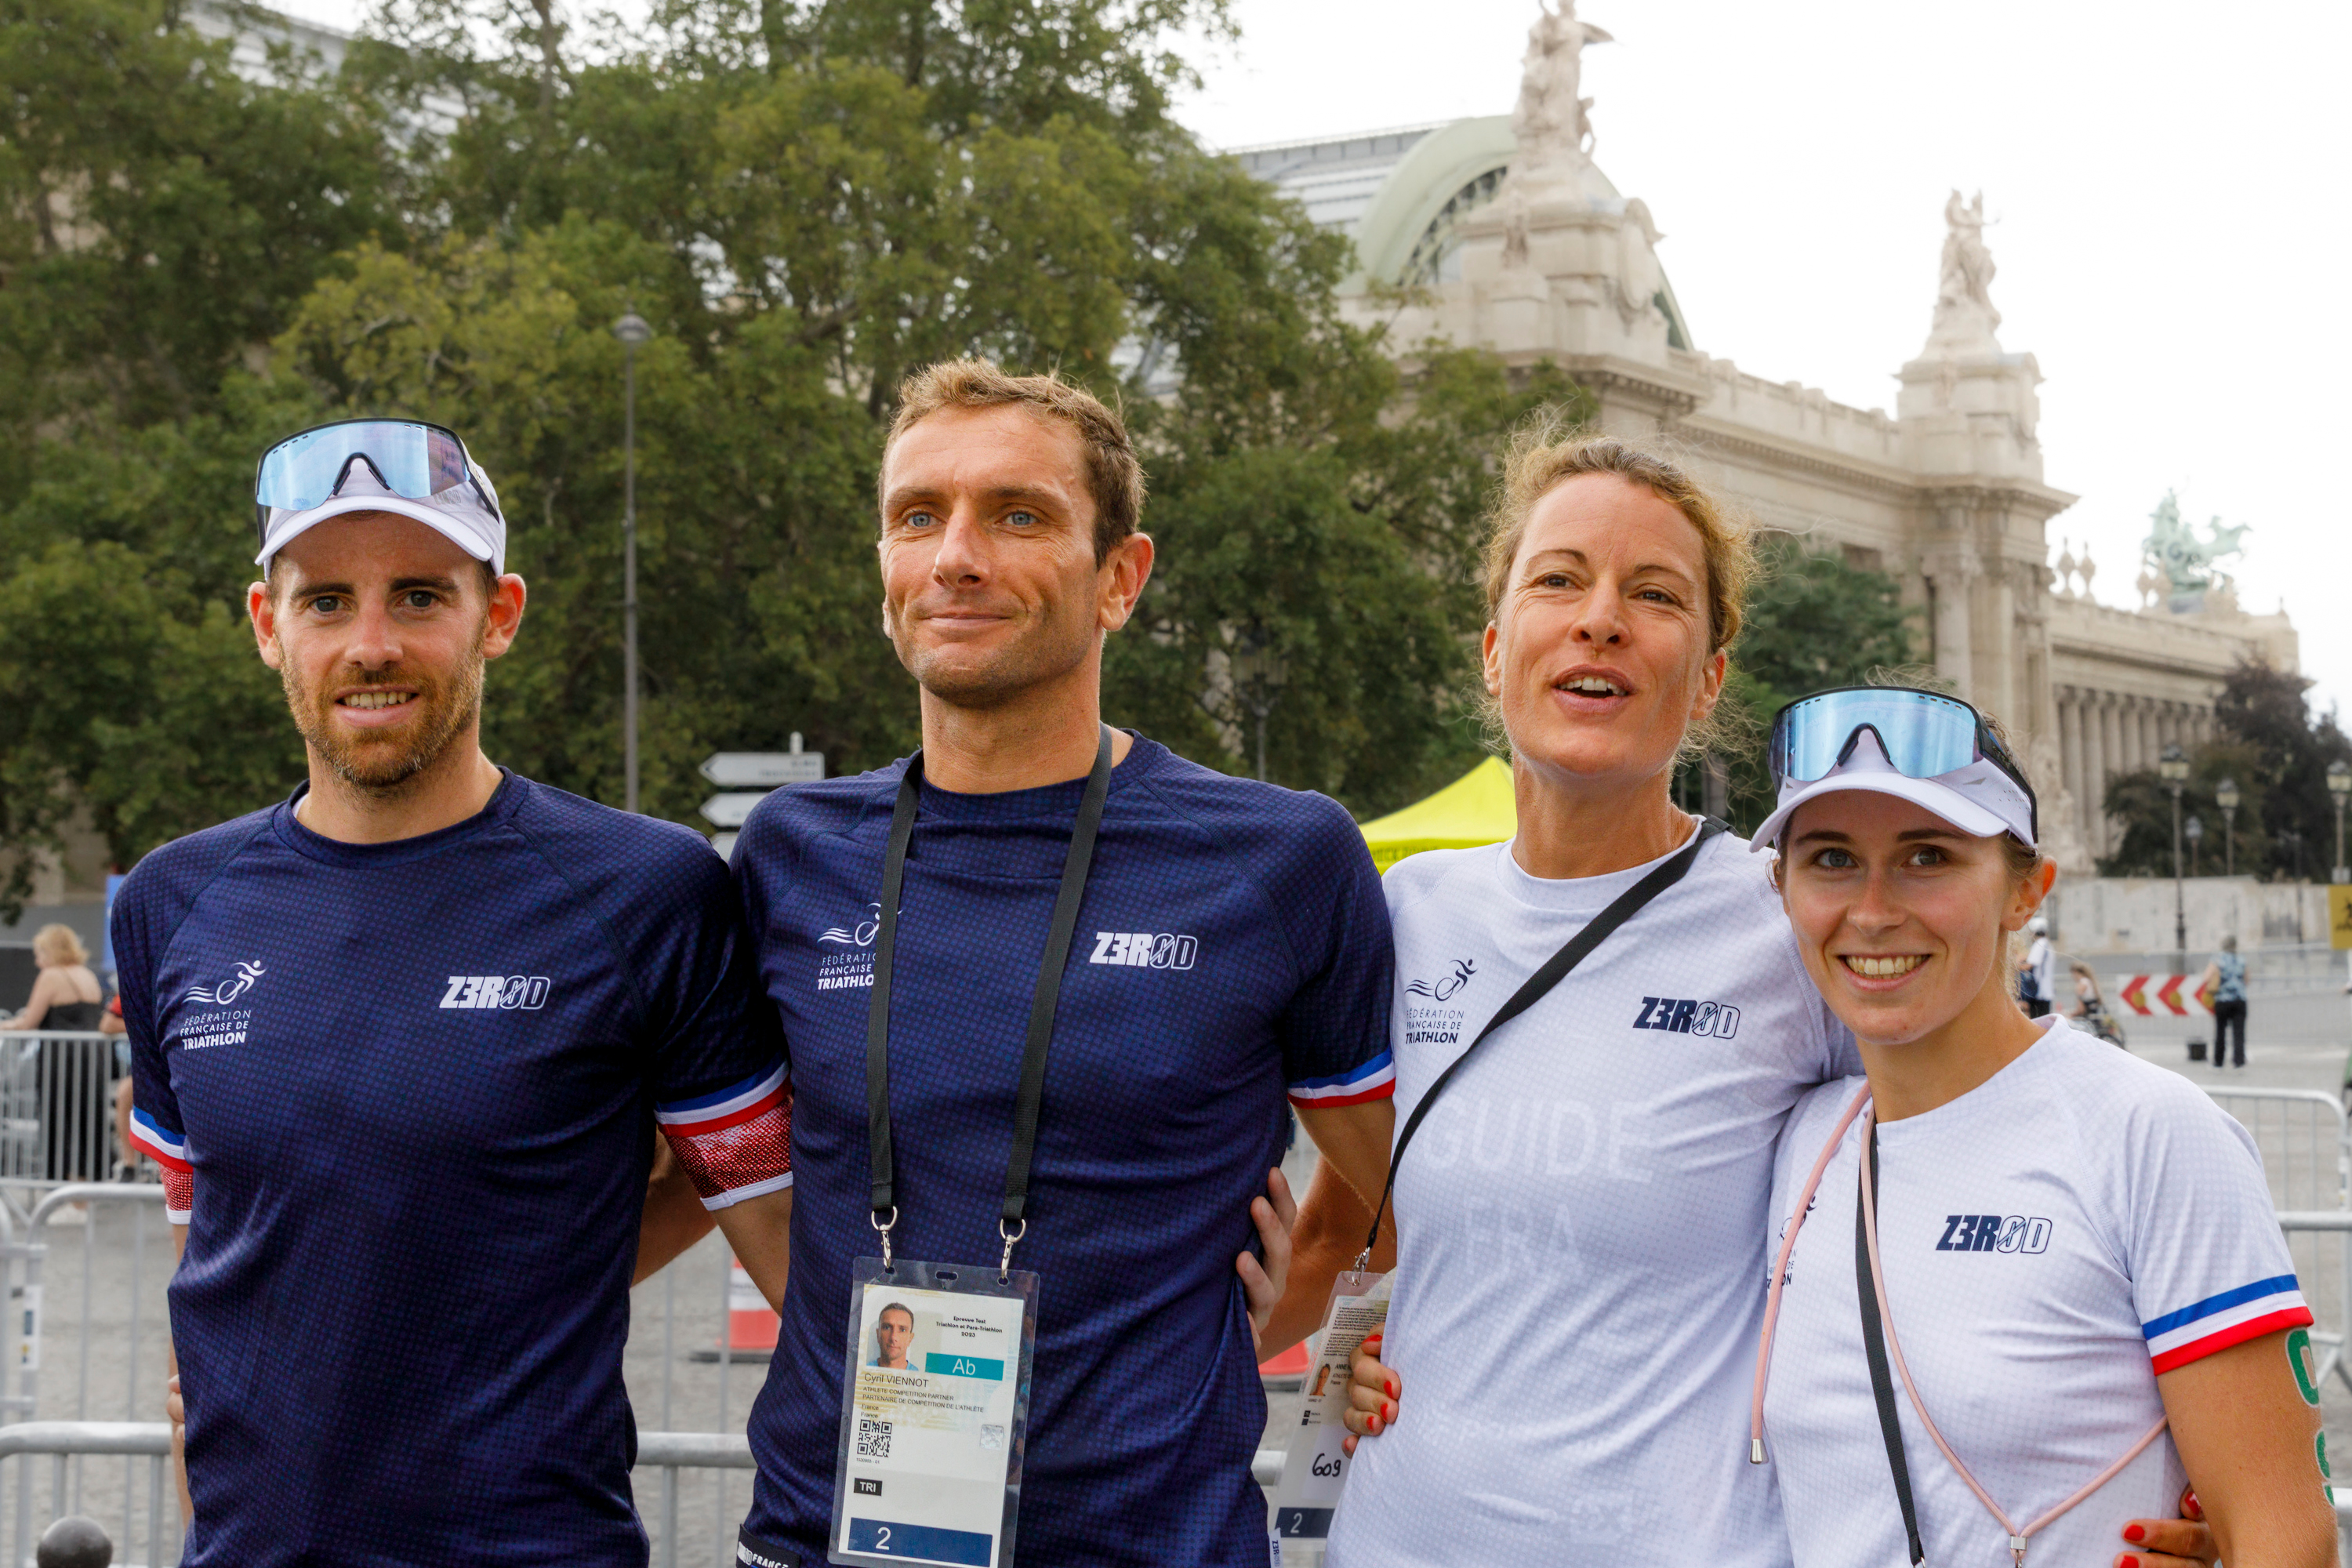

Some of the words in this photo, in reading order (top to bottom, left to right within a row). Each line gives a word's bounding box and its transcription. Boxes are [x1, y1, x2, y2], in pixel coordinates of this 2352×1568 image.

[822, 953, 876, 966] FÉDÉRATI
[819, 964, 872, 976] FRANÇAISE
[818, 974, 874, 990] TRIATHLO
[184, 1009, 251, 1027] FÉDÉRATION
[1406, 1021, 1446, 1030] FRANÇAISE
[180, 1022, 232, 1036] FRANÇAISE
[236, 1021, 249, 1030] DE
[182, 1031, 246, 1051] TRIATHLON
[1406, 1032, 1458, 1044] TRIATHLON
[1421, 1094, 1654, 1184] GUIDE
[1461, 1196, 1584, 1276] FRA
[952, 1358, 976, 1376] Ab
[864, 1373, 884, 1384] Cyril
[886, 1374, 929, 1388] VIENNOT
[862, 1394, 898, 1403] PARTENAIRE
[907, 1399, 946, 1408] COMPÉTITION
[889, 1388, 927, 1399] COMPETITION
[927, 1392, 954, 1401] PARTNER
[1312, 1453, 1341, 1477] 609
[860, 1481, 877, 1493] TRI
[1290, 1512, 1302, 1534] 2
[876, 1526, 891, 1550] 2
